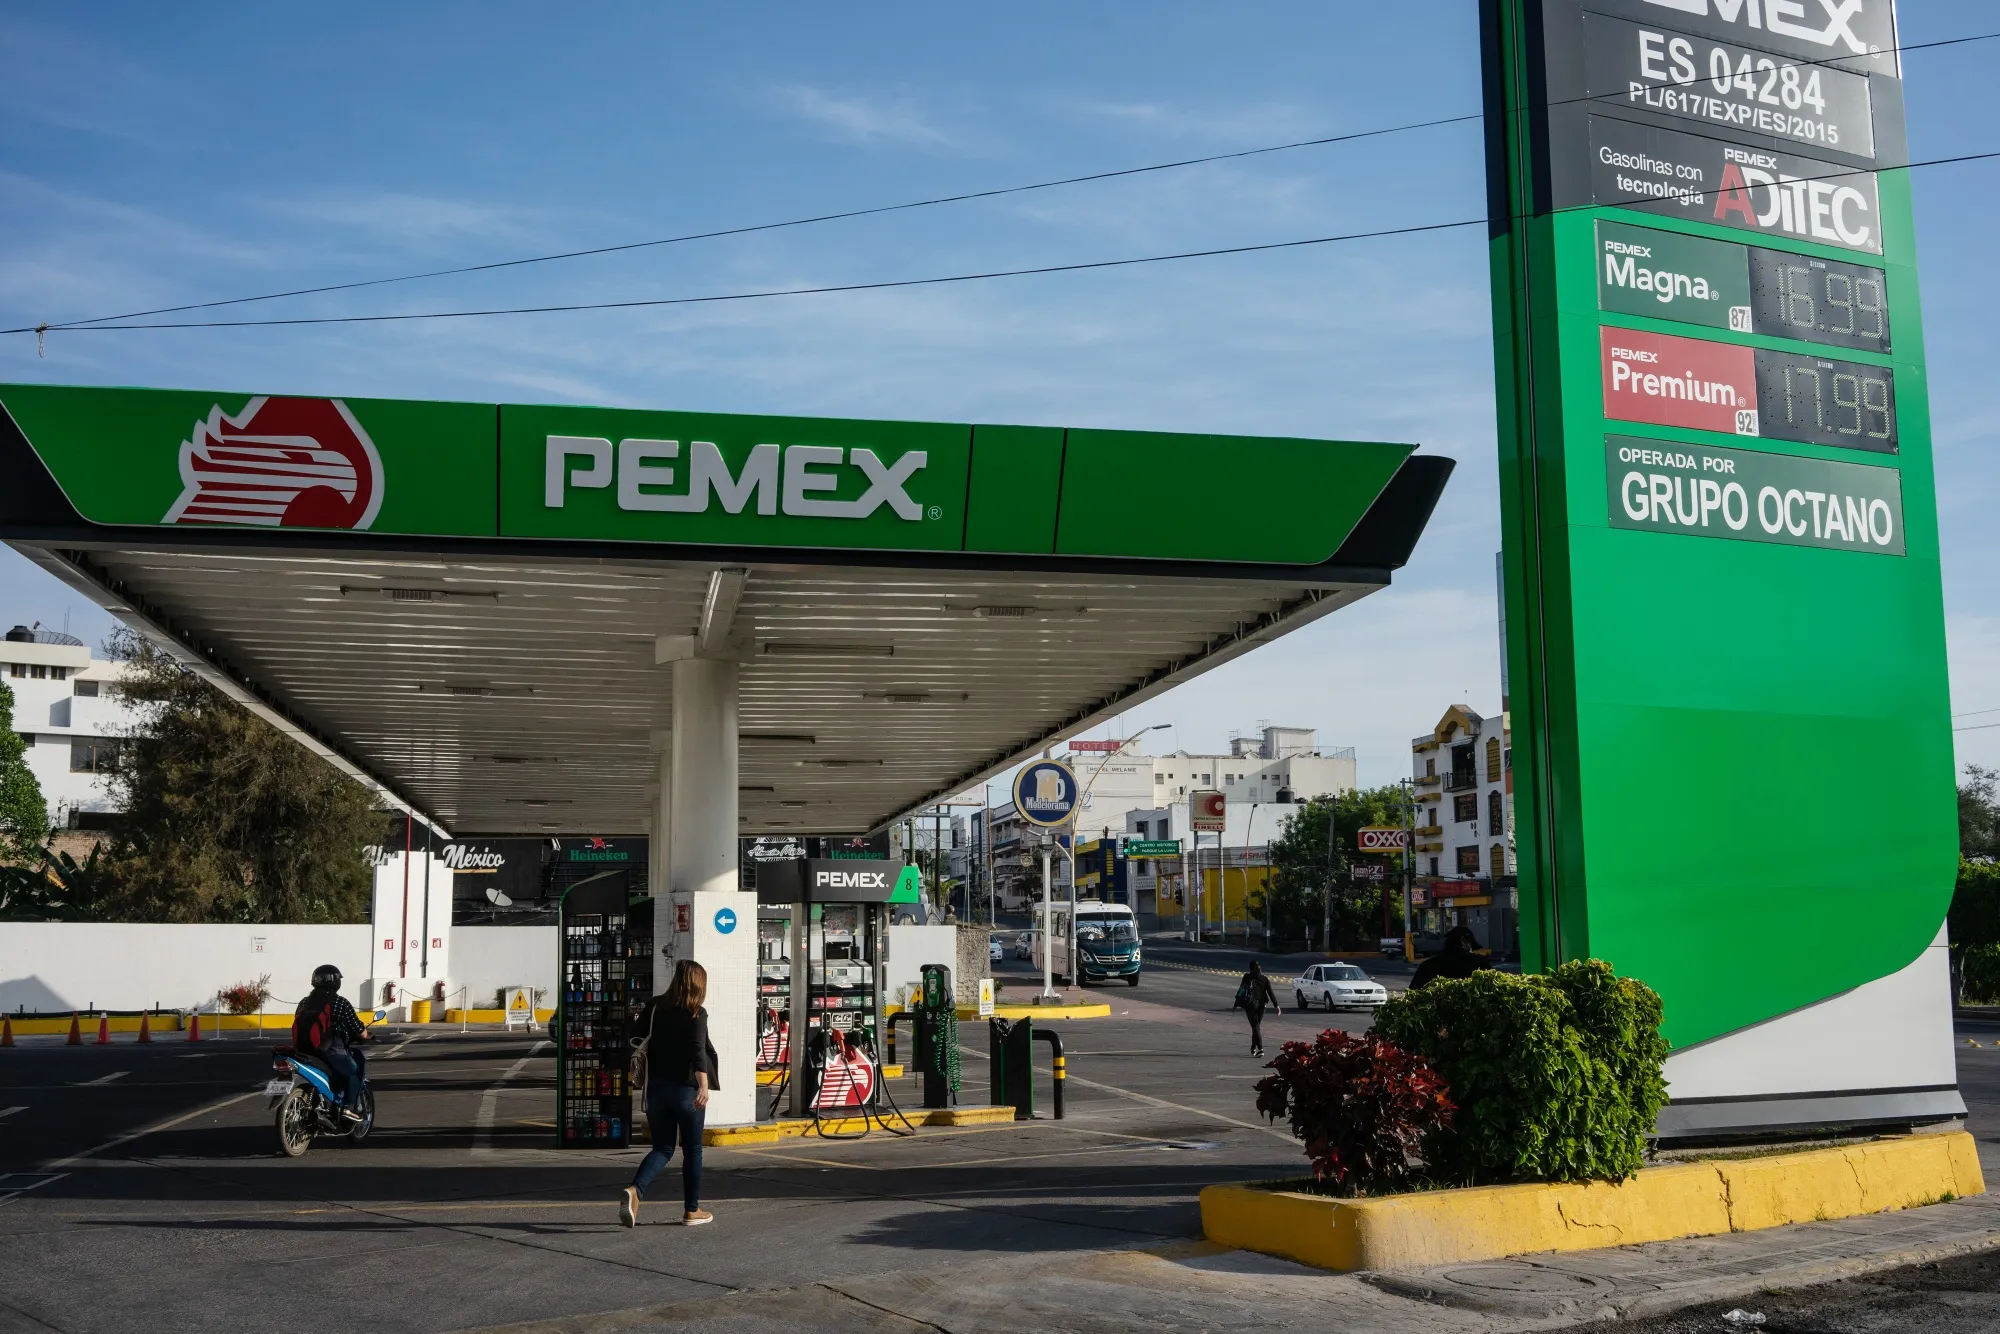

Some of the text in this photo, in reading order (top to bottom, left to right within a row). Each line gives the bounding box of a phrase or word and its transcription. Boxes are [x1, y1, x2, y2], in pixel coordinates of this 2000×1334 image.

[1639, 30, 1826, 115] ES 04284
[1629, 82, 1839, 144] PL/617/EXP/ES/2015
[1600, 147, 1703, 181] Gasolinas con
[1724, 148, 1777, 169] PEMEX
[1617, 174, 1704, 206] tecnología
[1605, 240, 1651, 258] PEMEX
[1606, 254, 1709, 303] Magna
[1731, 308, 1746, 330] 87
[1611, 347, 1658, 364] PEMEX
[1612, 360, 1736, 407] Premium
[1737, 411, 1753, 433] 92
[1619, 447, 1735, 474] OPERADA POR
[545, 435, 928, 521] PEMEX
[1621, 471, 1893, 546] GRUPO OCTANO
[1072, 742, 1118, 750] HOTEL
[1025, 797, 1070, 811] Modelorama
[442, 844, 505, 869] México
[570, 849, 628, 861] Heineken
[816, 871, 885, 888] PEMEX
[905, 878, 913, 891] 8
